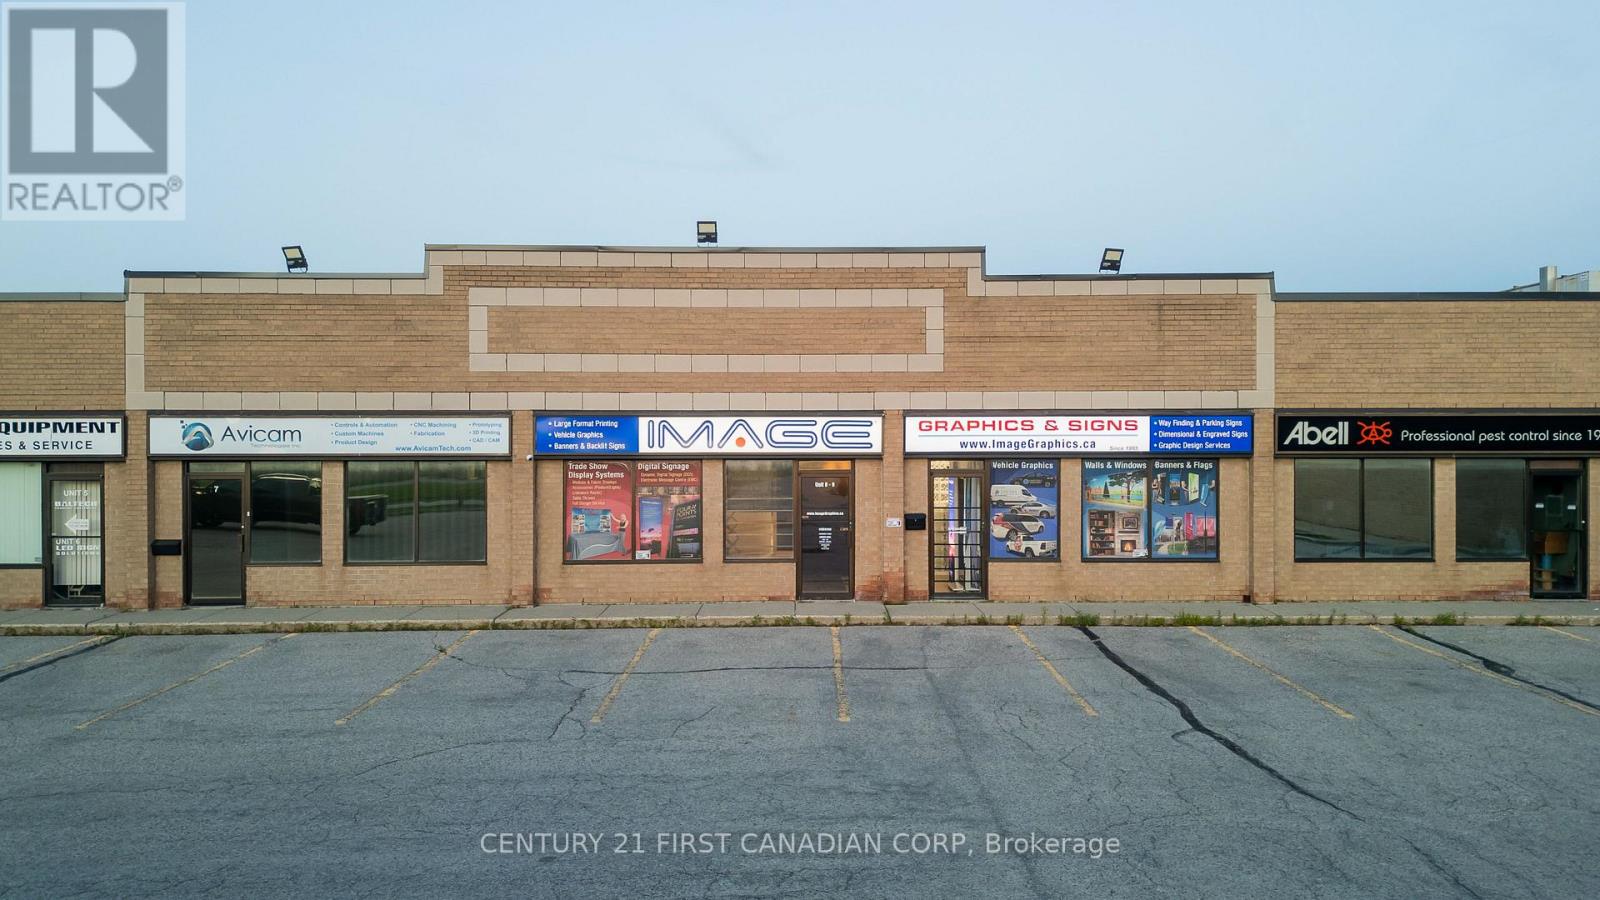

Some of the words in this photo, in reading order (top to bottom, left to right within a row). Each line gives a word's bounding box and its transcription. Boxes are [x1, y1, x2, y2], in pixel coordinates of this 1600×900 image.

[554, 420, 572, 428] Large
[573, 420, 594, 428] Format
[595, 420, 618, 429] Printing
[918, 420, 1034, 432] GRAPHICS
[1045, 420, 1059, 431] &
[1068, 420, 1138, 431] SIGNS
[1172, 420, 1195, 428] Finding
[1202, 420, 1224, 428] Parking
[1225, 420, 1243, 428] Signs
[221, 425, 302, 442] Avicam
[554, 431, 576, 439] Vehicle
[577, 431, 604, 440] Graphics
[648, 419, 873, 449] IMAGE
[1203, 431, 1230, 439] Engraved
[1231, 431, 1248, 439] Signs
[1283, 421, 1349, 445] Abell
[1401, 430, 1475, 441] Professional
[1478, 431, 1505, 444] pest
[1508, 430, 1549, 441] control
[1552, 430, 1583, 441] since
[1587, 429, 1600, 441] 19
[19, 441, 26, 450] &
[33, 440, 93, 450] SERVICE
[554, 442, 579, 450] Banners
[580, 442, 585, 450] &
[586, 442, 608, 450] Backlit
[609, 442, 626, 451] Signs
[959, 439, 1096, 450] www.ImageGraphics.ca
[1182, 442, 1204, 450] Design
[589, 462, 608, 470] Show
[637, 463, 661, 471] Digital
[661, 462, 690, 471] Signage
[992, 461, 1019, 469] Vehicle
[1021, 461, 1054, 470] Graphics
[1085, 461, 1104, 469] Walls
[1106, 461, 1113, 469] &
[1114, 461, 1147, 469] Windows
[1154, 461, 1184, 469] Banners
[1185, 461, 1193, 469] &
[1193, 461, 1213, 470] Flags
[568, 471, 594, 479] Display
[595, 471, 625, 479] Systems
[63, 489, 82, 497] UNIT
